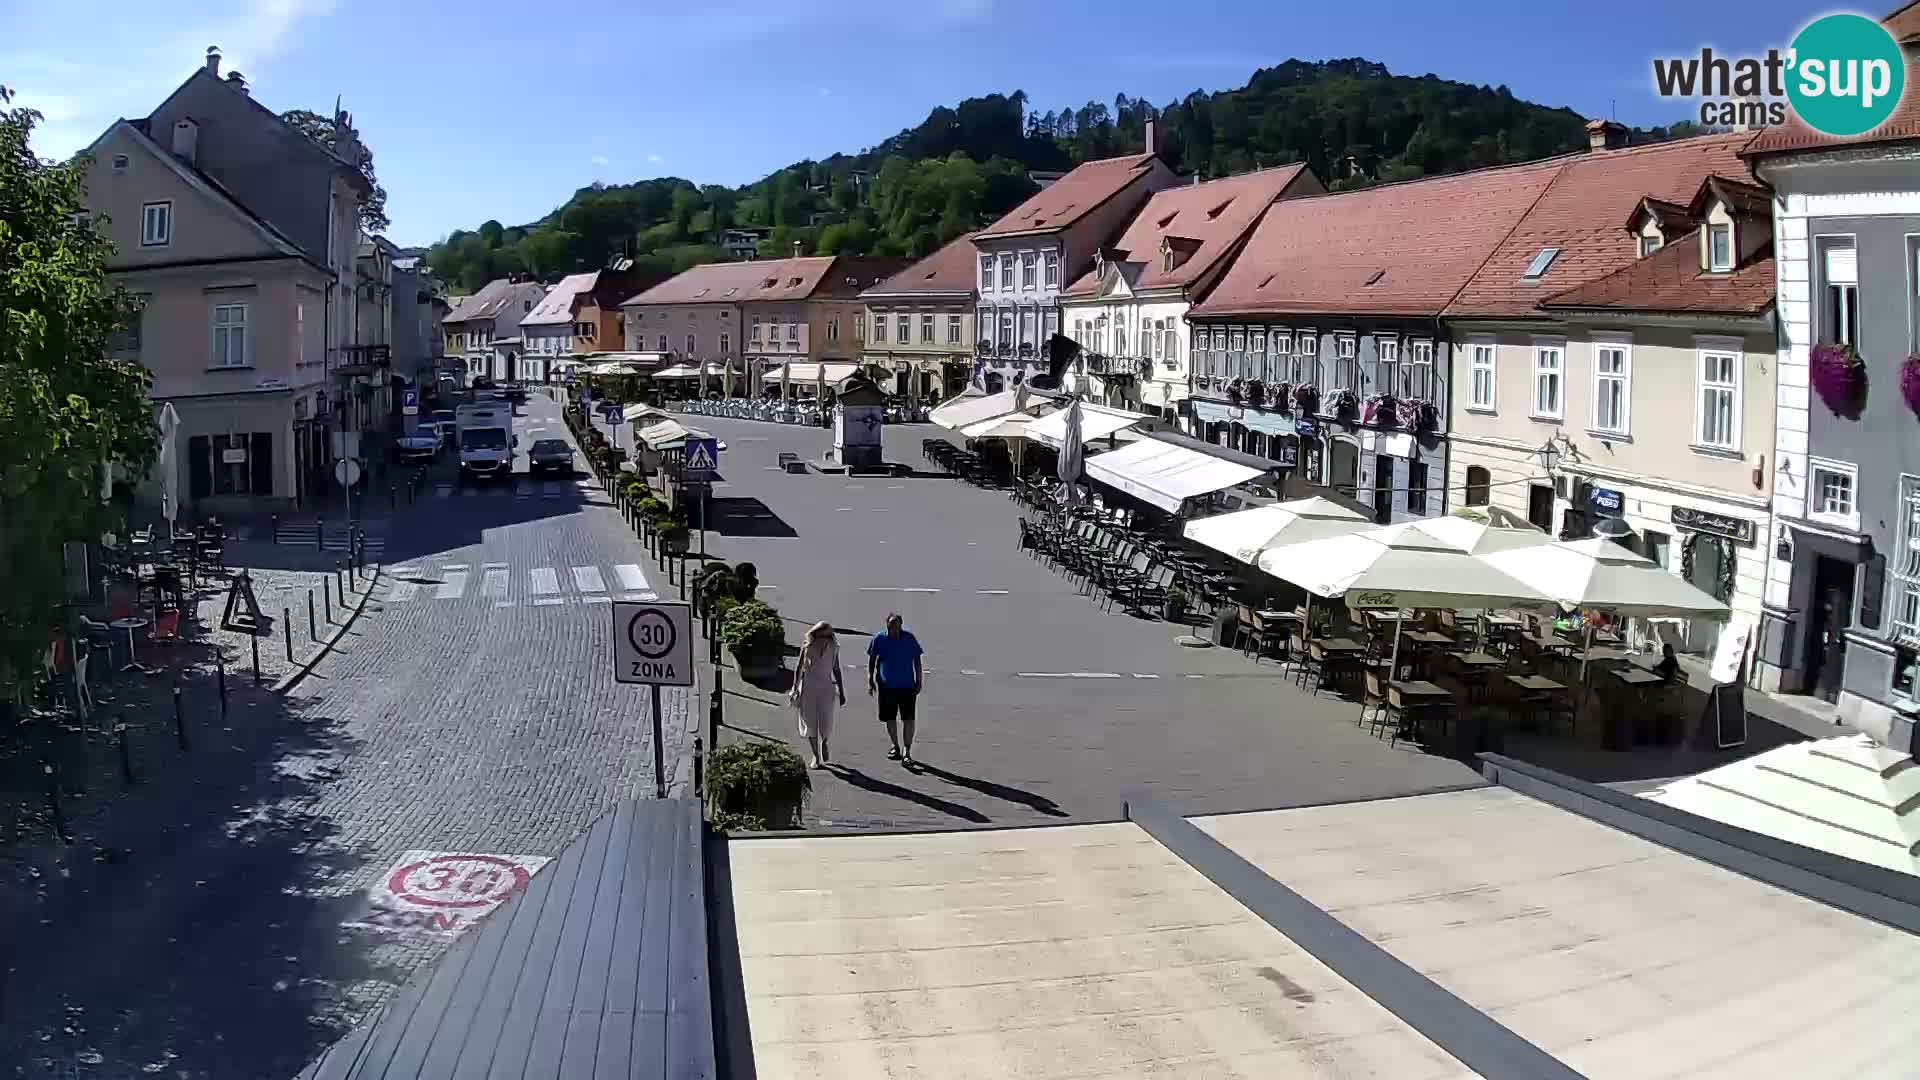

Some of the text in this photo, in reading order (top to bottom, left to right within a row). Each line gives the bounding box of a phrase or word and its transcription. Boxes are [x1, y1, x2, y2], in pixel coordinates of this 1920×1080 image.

[406, 393, 415, 405] P
[640, 625, 664, 645] 30
[631, 661, 675, 679] ZONA
[417, 866, 503, 895] 30
